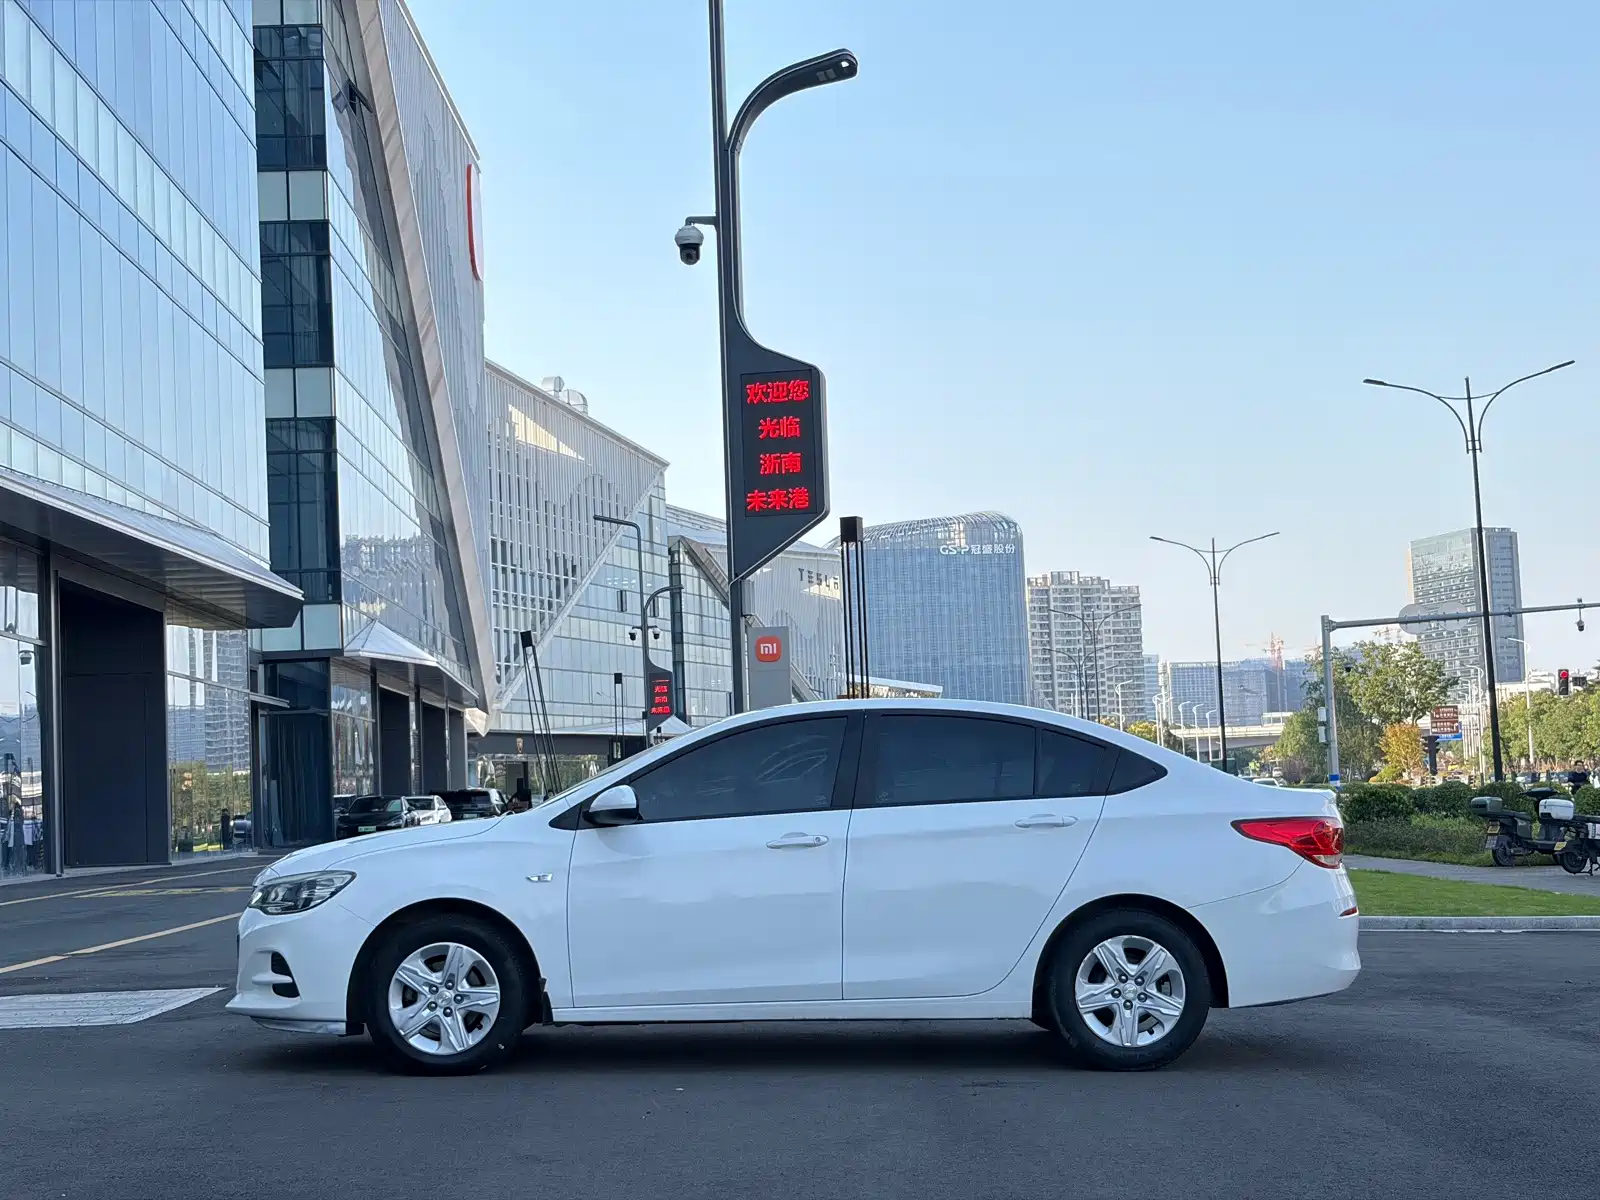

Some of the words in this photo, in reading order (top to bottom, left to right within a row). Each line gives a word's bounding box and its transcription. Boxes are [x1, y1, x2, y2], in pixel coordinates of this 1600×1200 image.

[745, 380, 809, 404] 欢迎您
[758, 416, 801, 439] 光临
[760, 451, 802, 475] 浙南
[746, 487, 809, 512] 未来港
[970, 544, 1015, 555] 冠盛股份
[797, 567, 839, 590] TESLA
